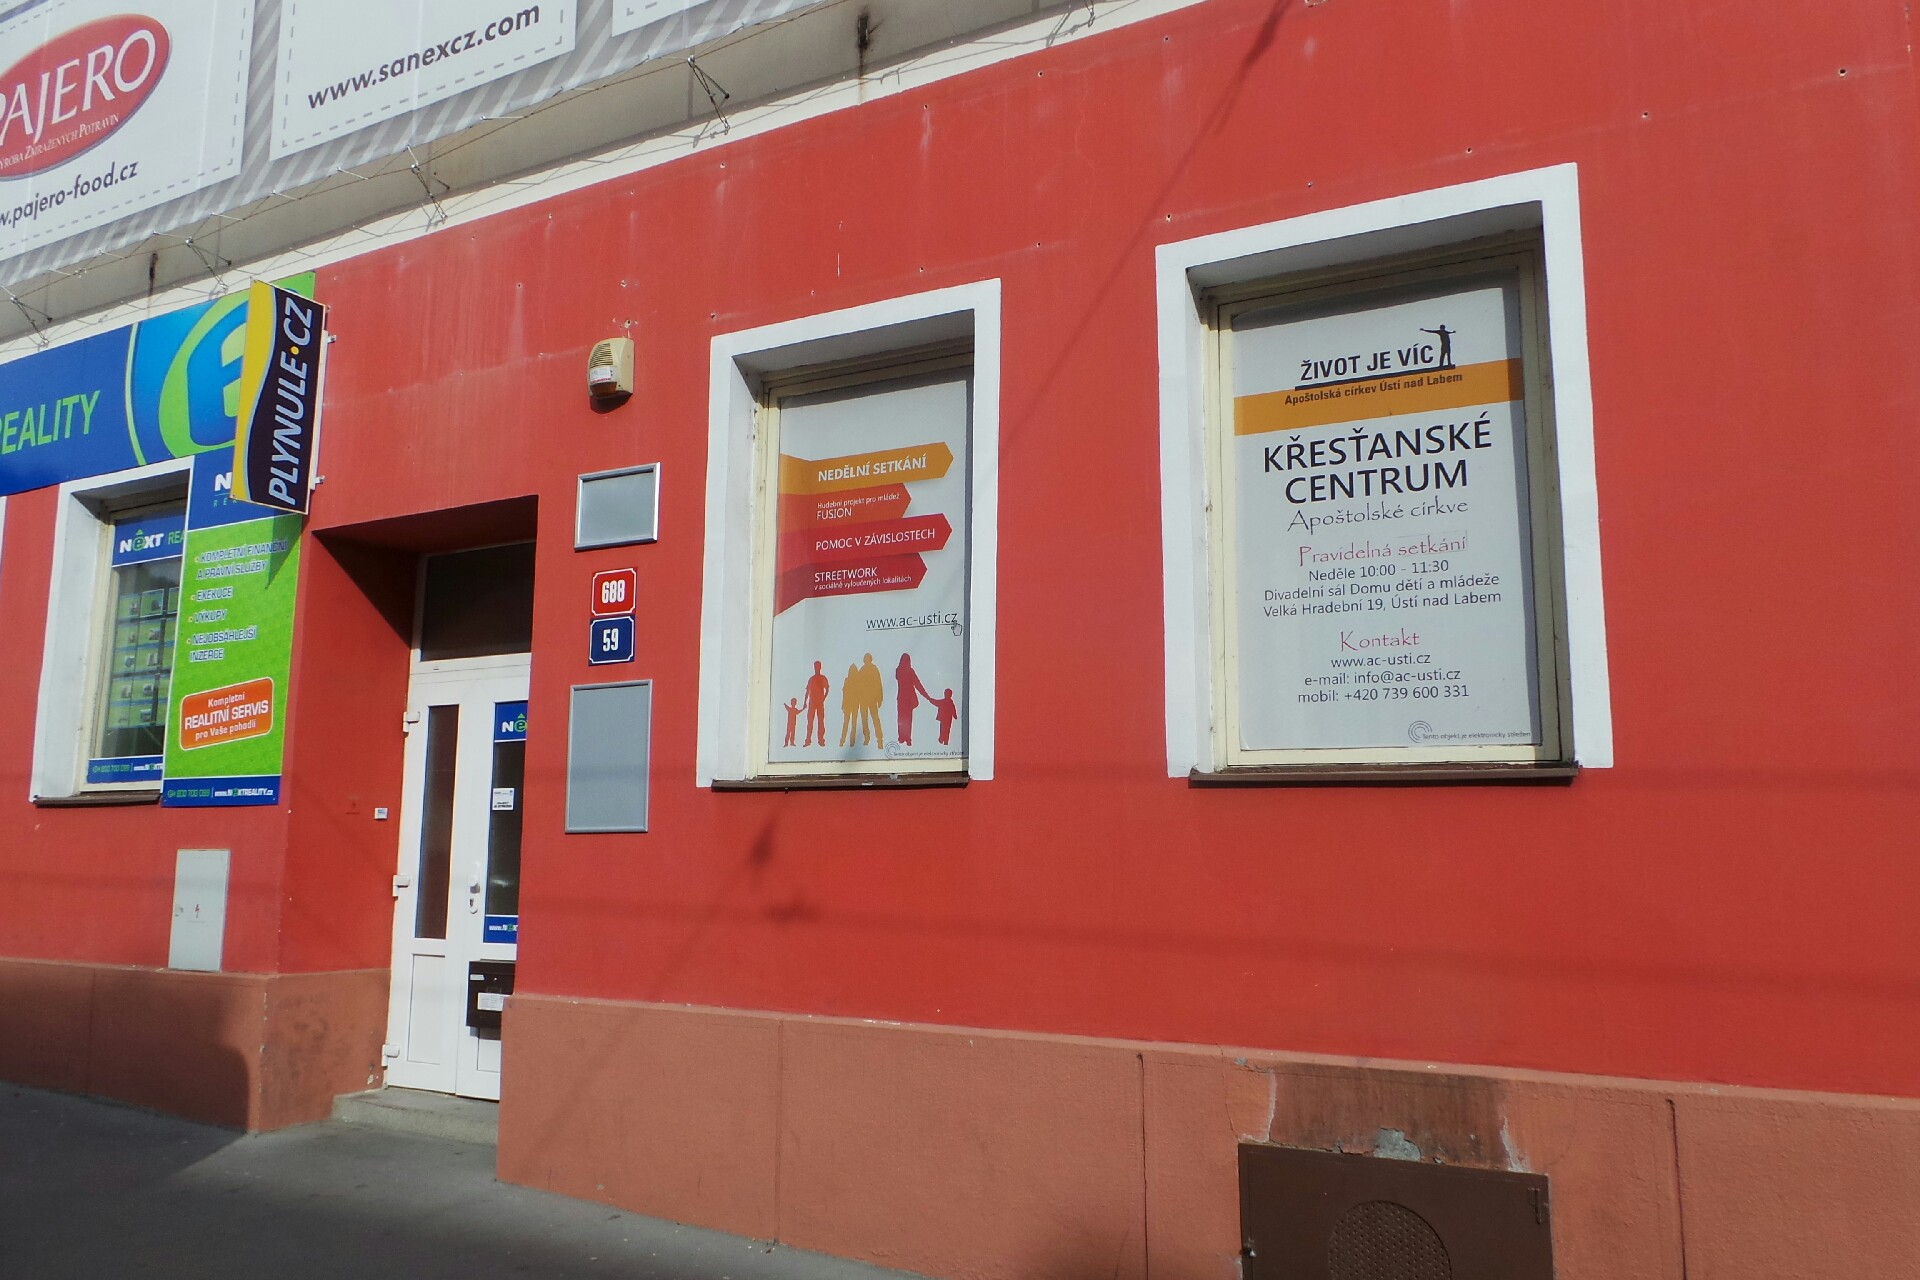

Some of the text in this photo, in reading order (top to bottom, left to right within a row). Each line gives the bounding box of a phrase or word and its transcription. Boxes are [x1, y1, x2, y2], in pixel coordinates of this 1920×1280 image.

[307, 5, 540, 108] www.sanexcz.com
[0, 30, 156, 146] AJERO
[1300, 343, 1434, 381] ŽIVOT JE VÍC
[1284, 372, 1463, 406] Apoštolská církev Ústí nad Labem
[0, 389, 101, 455] EALITY
[1263, 411, 1492, 473] KŘESŤANSKÉ
[818, 453, 927, 482] NEDĚLNÍ SETKÁNÍ
[1285, 459, 1468, 504] CENTRUM
[816, 507, 852, 520] FUSION
[843, 497, 865, 507] projekt
[865, 497, 877, 506] pro
[1287, 495, 1469, 535] Apoštolské církve
[815, 528, 936, 551] POMOC V ZÁVISLOSTECH
[1299, 535, 1467, 567] Pravidelná setkání
[196, 567, 205, 580] A
[814, 566, 878, 583] STREETWORK
[1308, 567, 1356, 582] Neděle
[1360, 563, 1396, 578] 10:00
[1411, 559, 1450, 575] 11:30
[601, 579, 626, 604] 688
[1264, 572, 1500, 601] Divadelní sál Domu dětí a mládeže
[1263, 590, 1502, 618] Velká Hradební 19, Ústí nad Labem
[866, 610, 958, 629] www.ac-usti.cz
[602, 627, 619, 652] 59
[1340, 627, 1421, 652] Kontakt
[1330, 652, 1432, 669] www.ac-usti.cz
[1303, 668, 1462, 687] e-mail: info@ac-usti.cz
[207, 691, 246, 708] Kompletní
[1297, 684, 1470, 704] mobil: +420 739 600 331
[184, 700, 269, 730] REALITNÍ SERVIS
[195, 730, 209, 742] pro
[210, 725, 228, 737] Vaše
